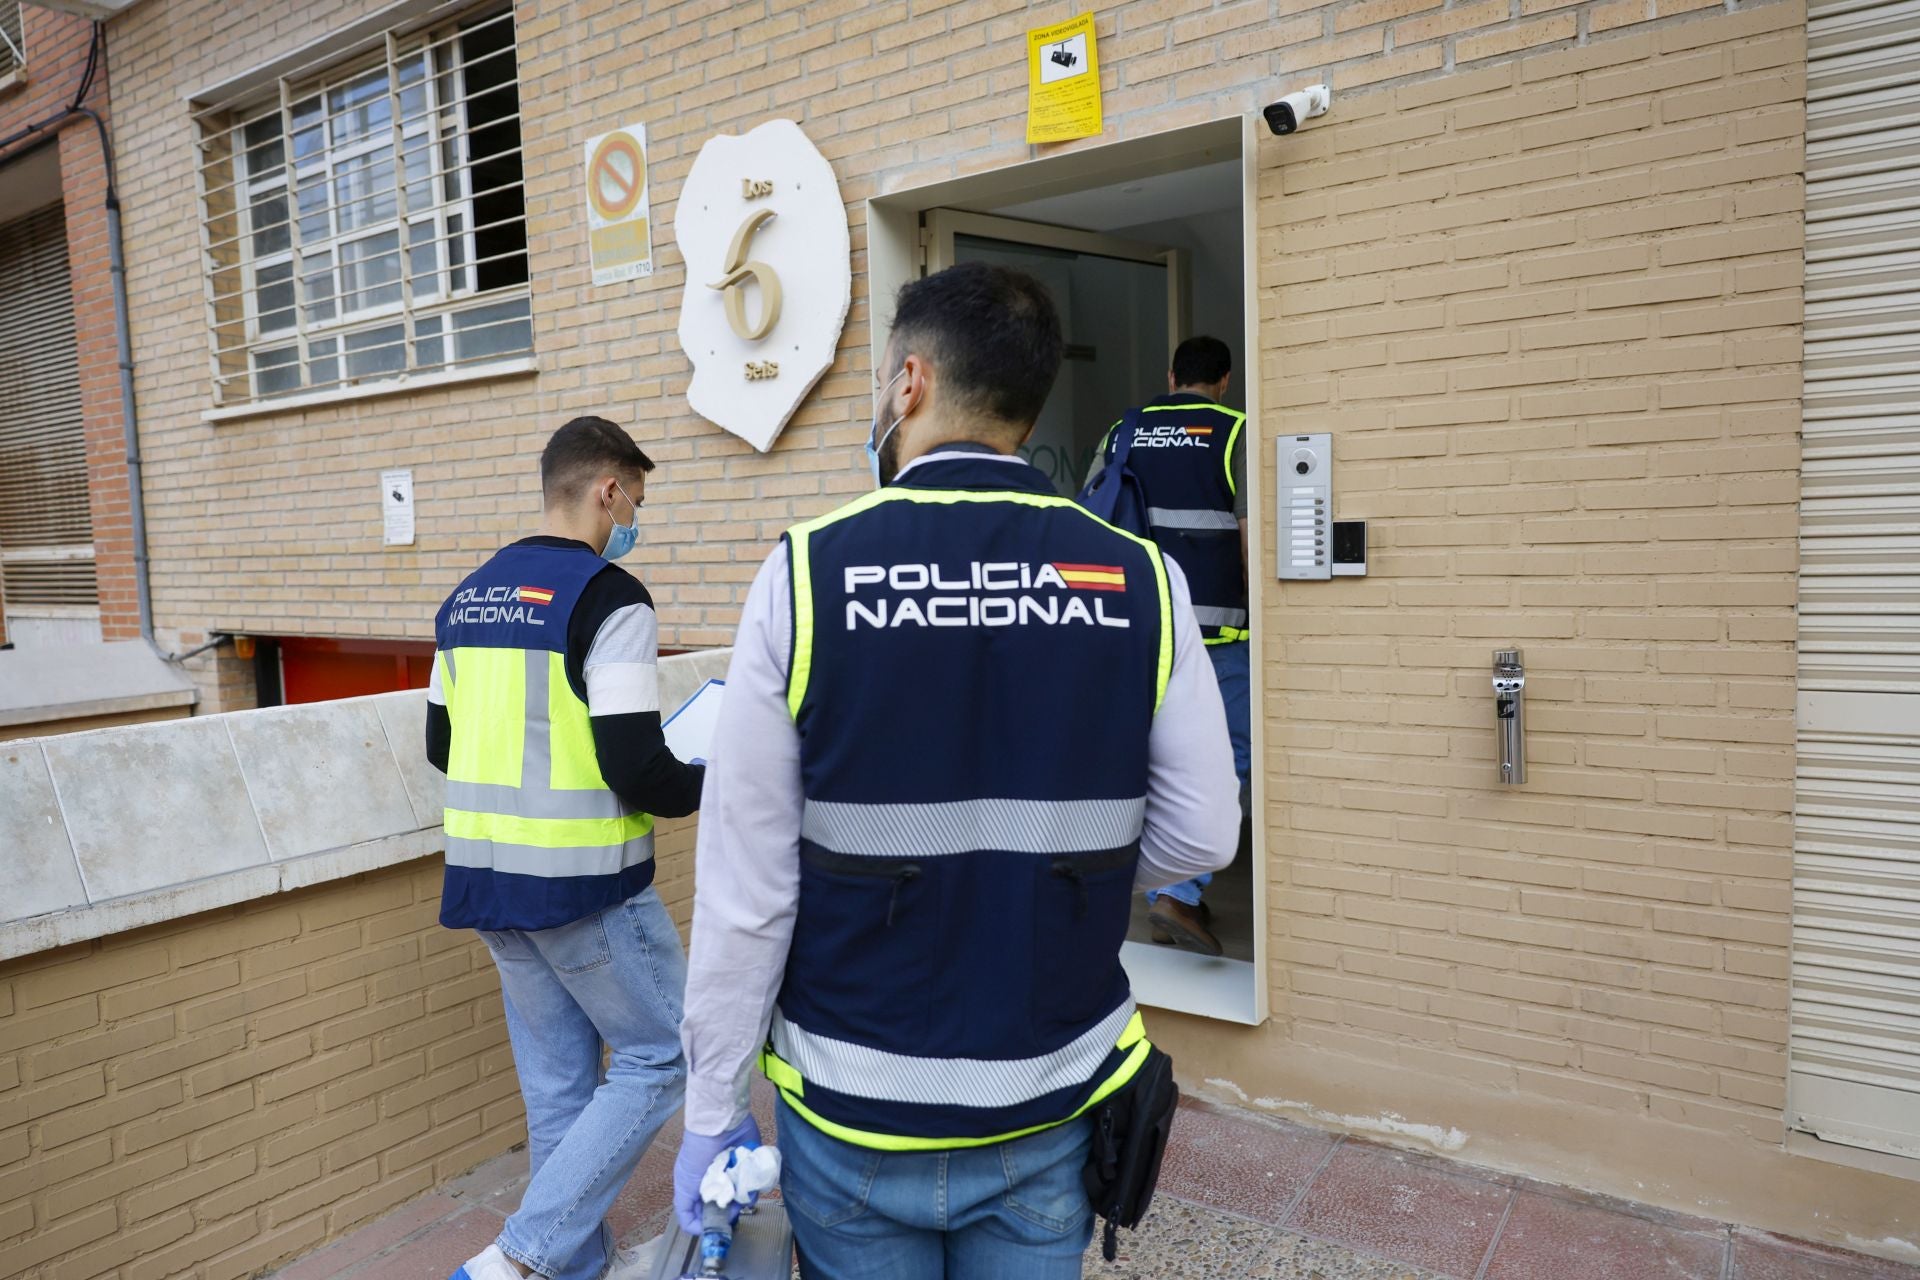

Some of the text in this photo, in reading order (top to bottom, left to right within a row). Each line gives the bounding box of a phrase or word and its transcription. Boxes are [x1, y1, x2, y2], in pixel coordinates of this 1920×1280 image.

[1033, 32, 1050, 41] ZONA
[741, 177, 774, 200] Los
[705, 208, 783, 340] 6
[744, 360, 780, 381] Seis
[1112, 436, 1210, 452] CIONAL
[447, 606, 545, 627] NACIONAL
[846, 595, 1130, 631] NACIONAL
